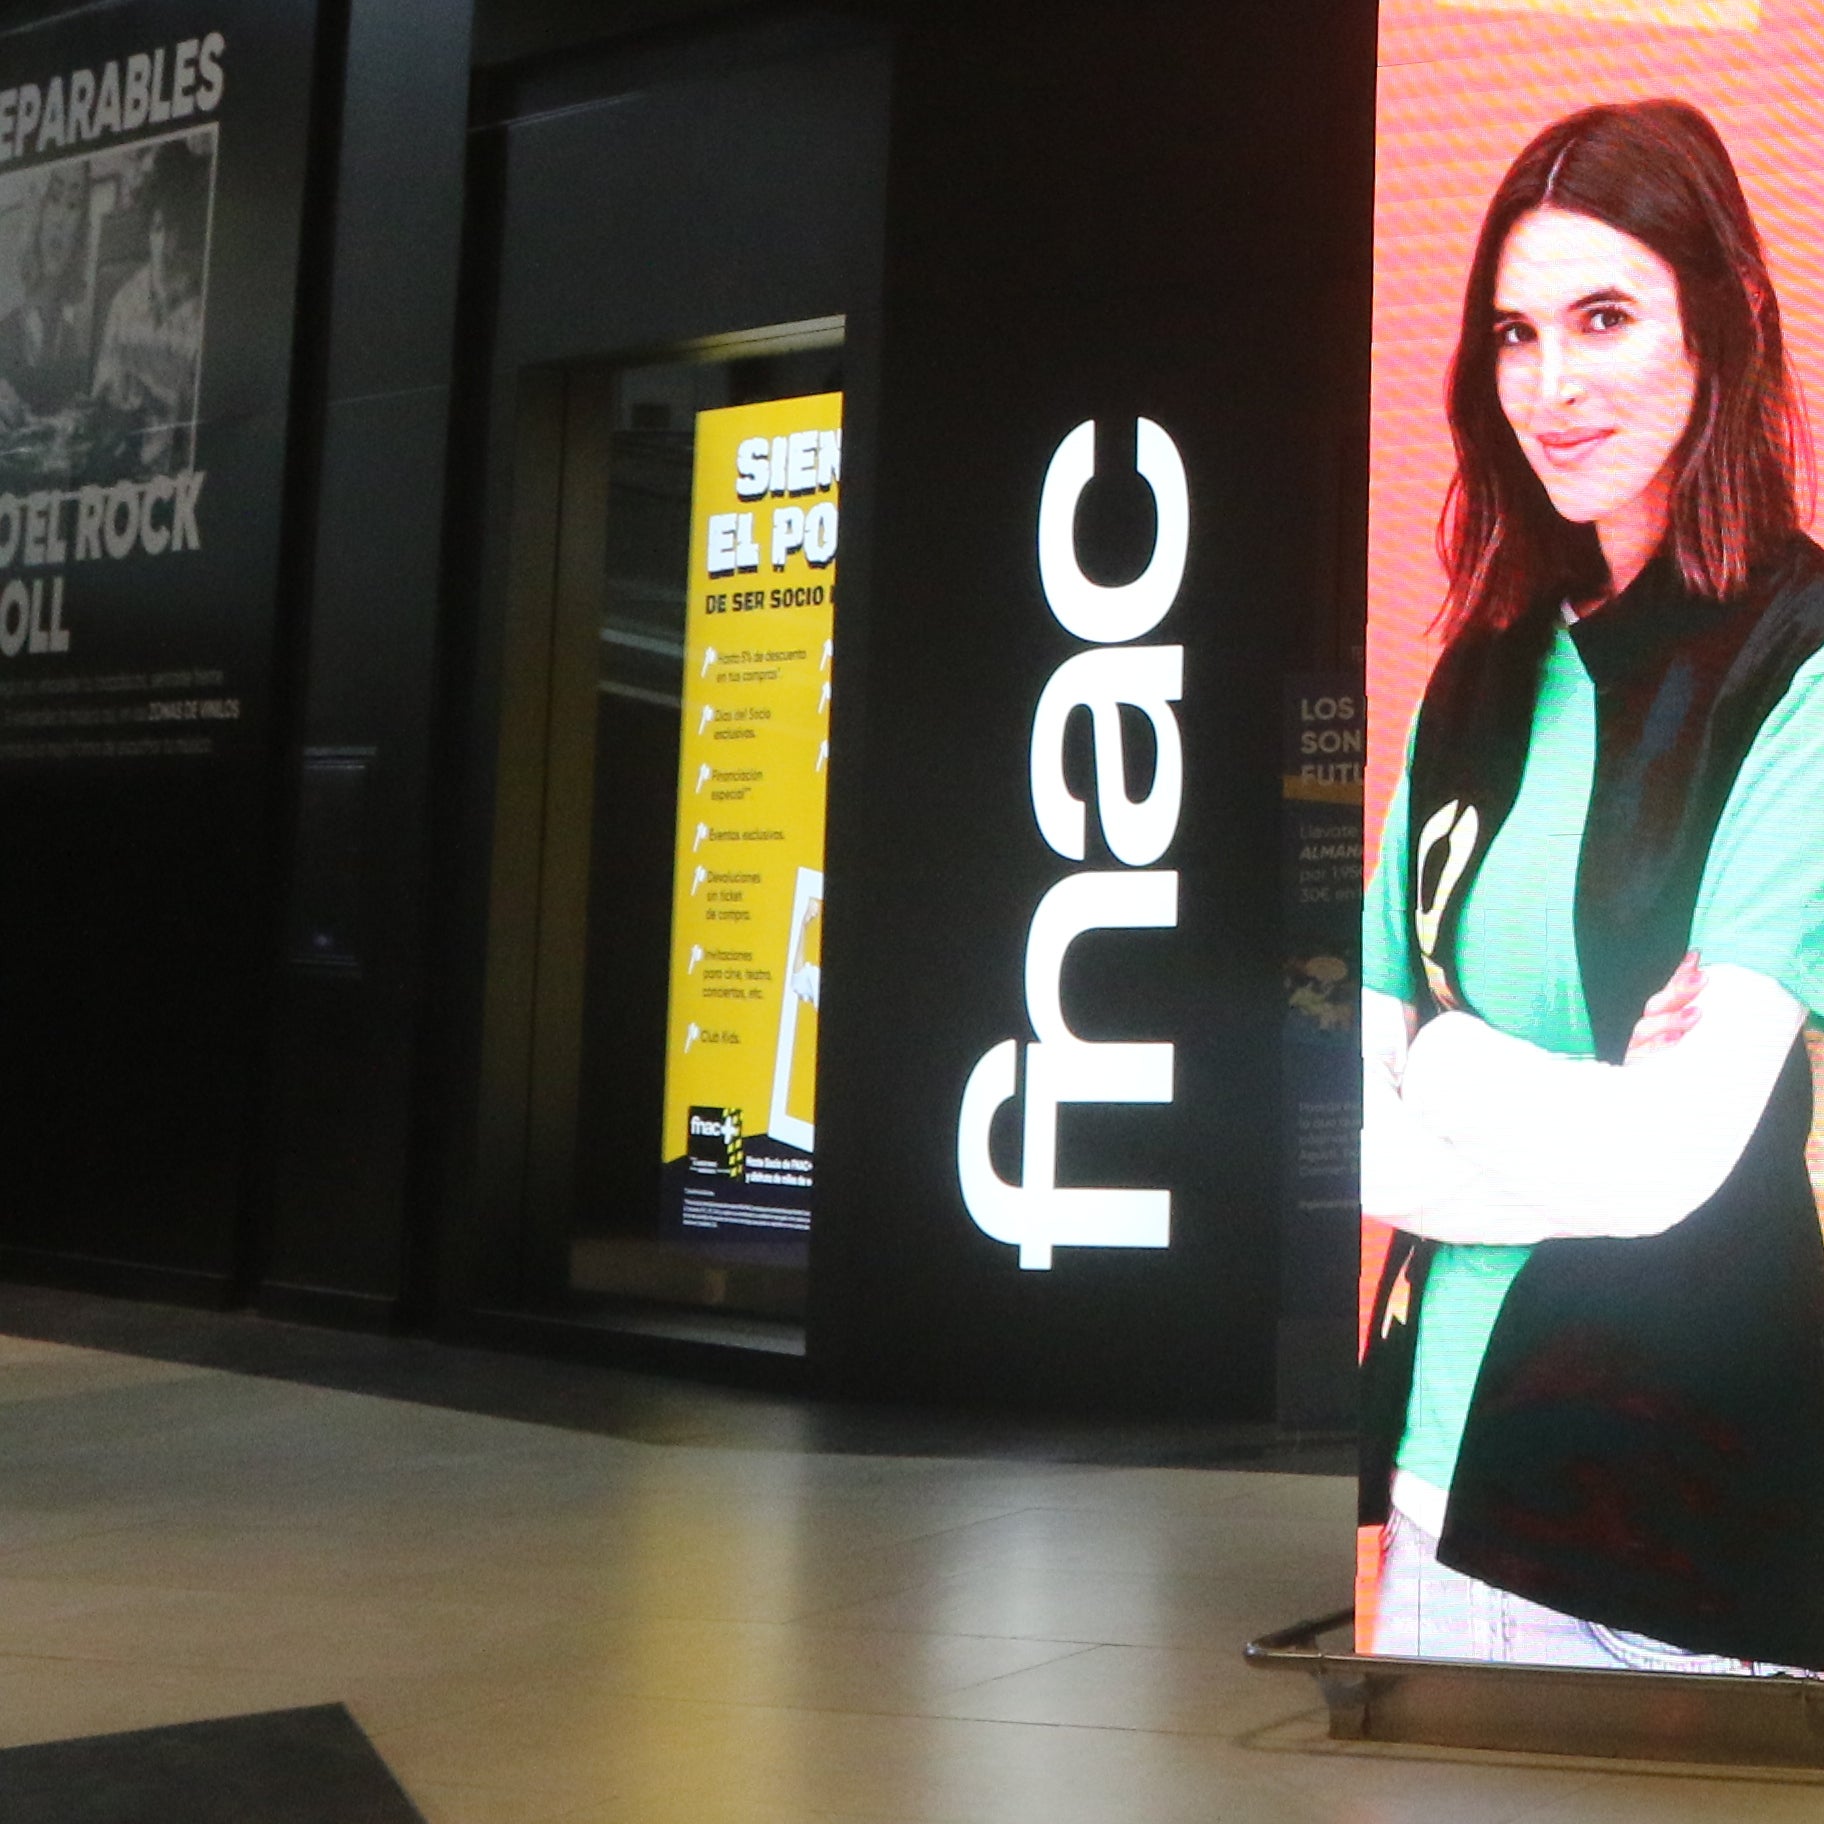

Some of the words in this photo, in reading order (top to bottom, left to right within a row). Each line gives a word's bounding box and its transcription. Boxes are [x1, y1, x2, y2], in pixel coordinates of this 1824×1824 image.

[75, 471, 207, 561] ROCK
[707, 512, 759, 579] EL
[0, 576, 70, 656] OLL
[705, 594, 727, 615] DE
[732, 591, 764, 612] SER
[771, 586, 824, 609] SOCIO
[1301, 696, 1355, 722] LOS
[1301, 729, 1362, 755] SON
[957, 416, 1189, 1269] fnac
